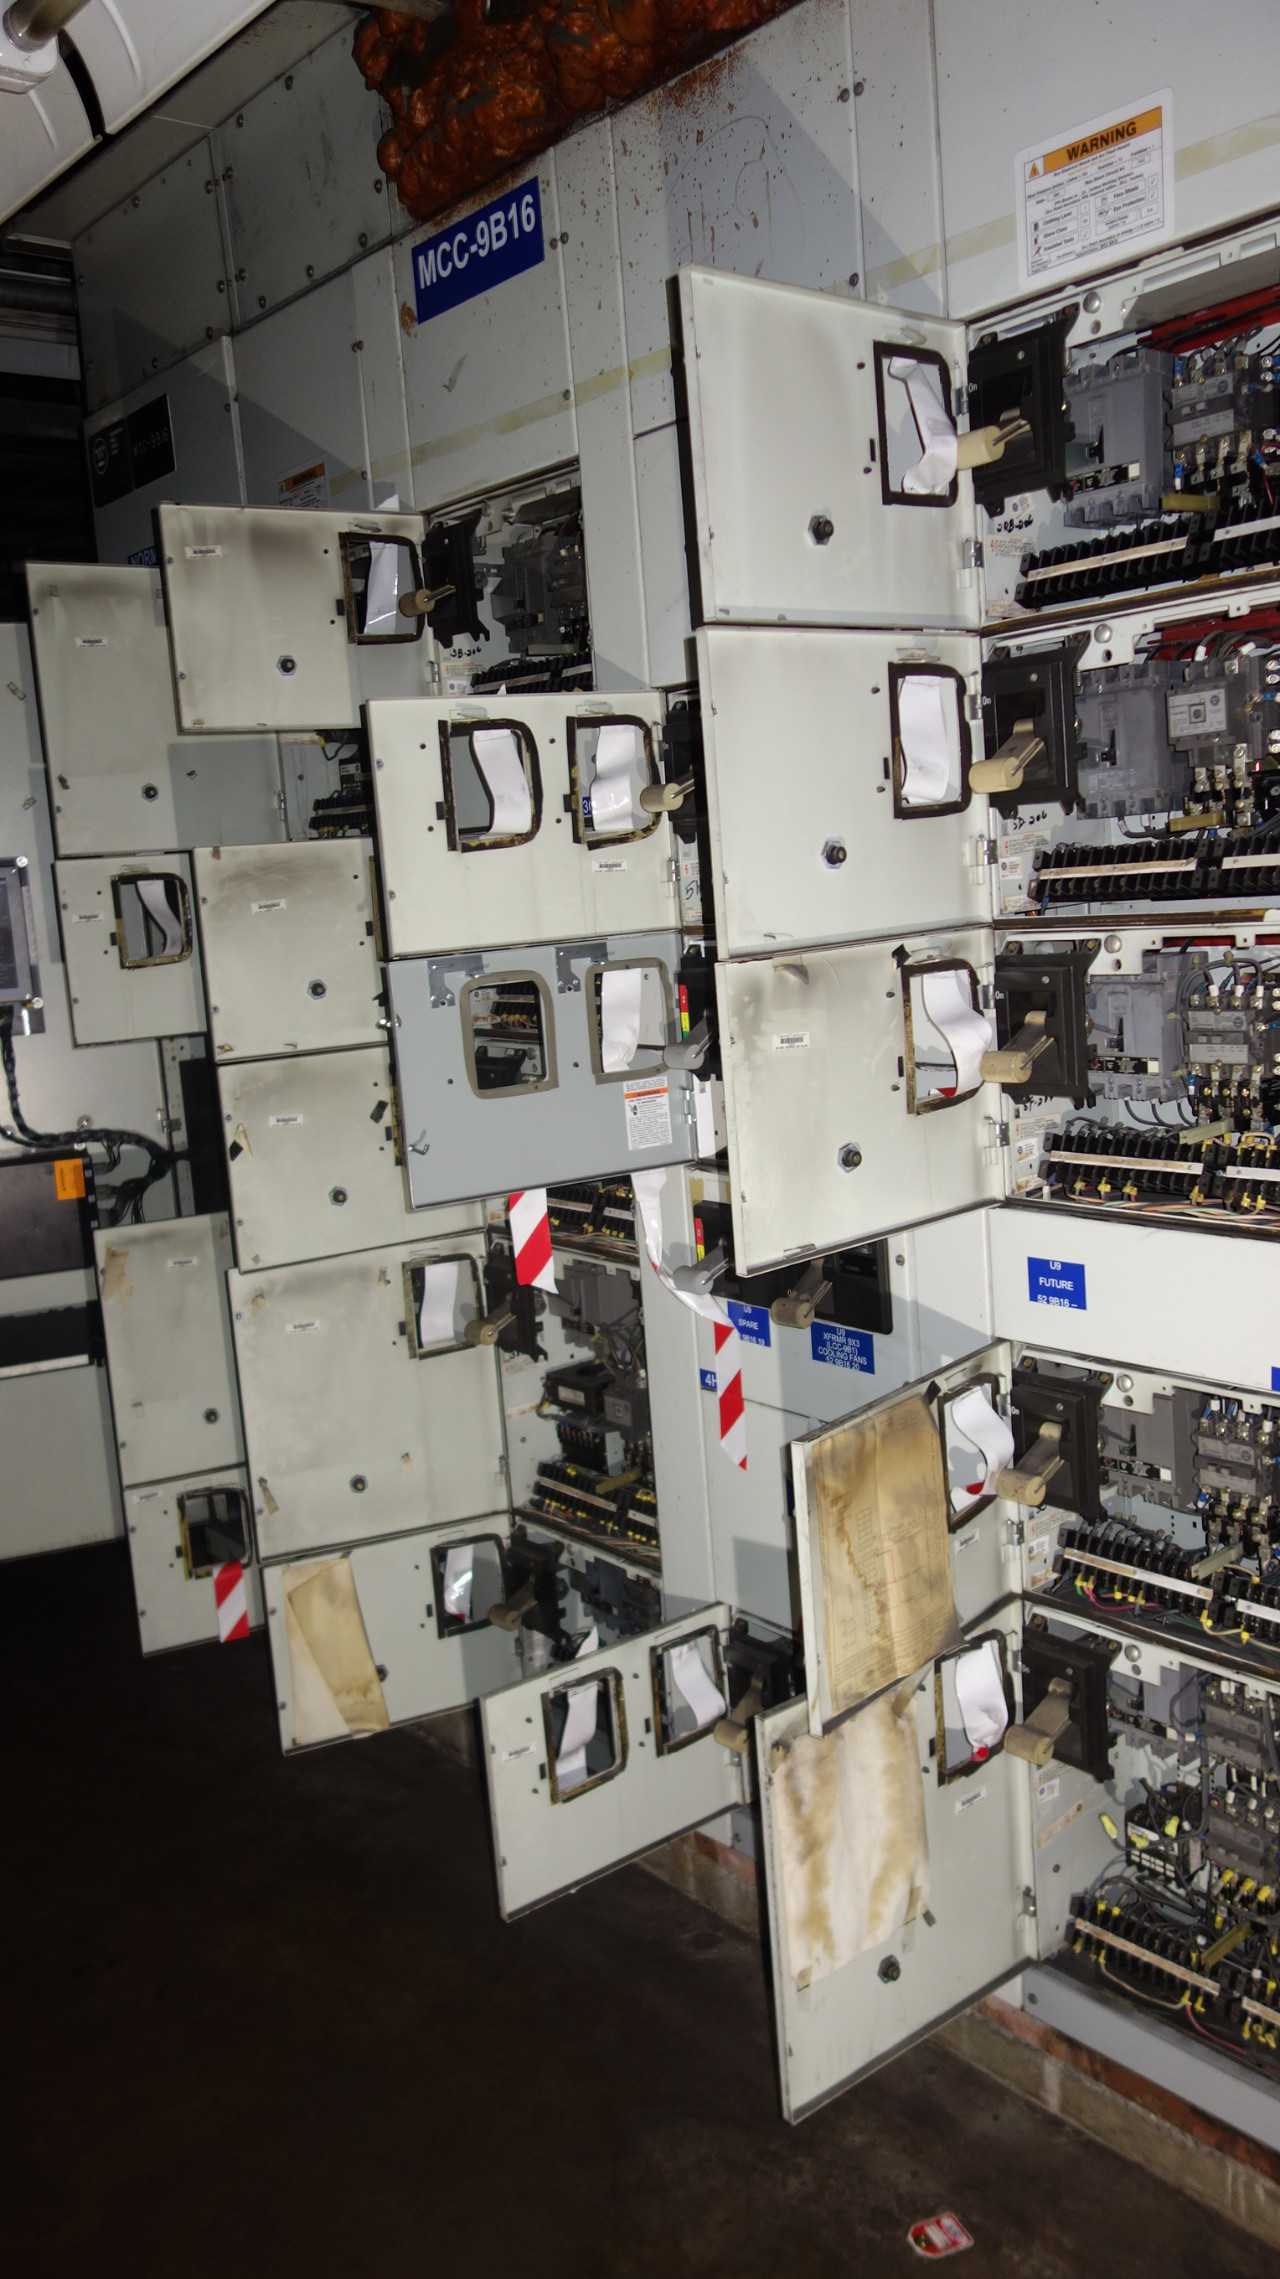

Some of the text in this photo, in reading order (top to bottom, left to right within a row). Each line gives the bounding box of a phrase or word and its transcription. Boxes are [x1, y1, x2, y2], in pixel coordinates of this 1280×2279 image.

[1066, 121, 1137, 161] WARNING
[418, 194, 536, 289] MCC-9B16
[968, 382, 978, 392] On
[982, 695, 992, 705] On
[995, 990, 1005, 1000] On
[1038, 1276, 1074, 1291] FUTURE
[738, 1318, 760, 1330] SPARE
[818, 1346, 868, 1366] COOLING FANS
